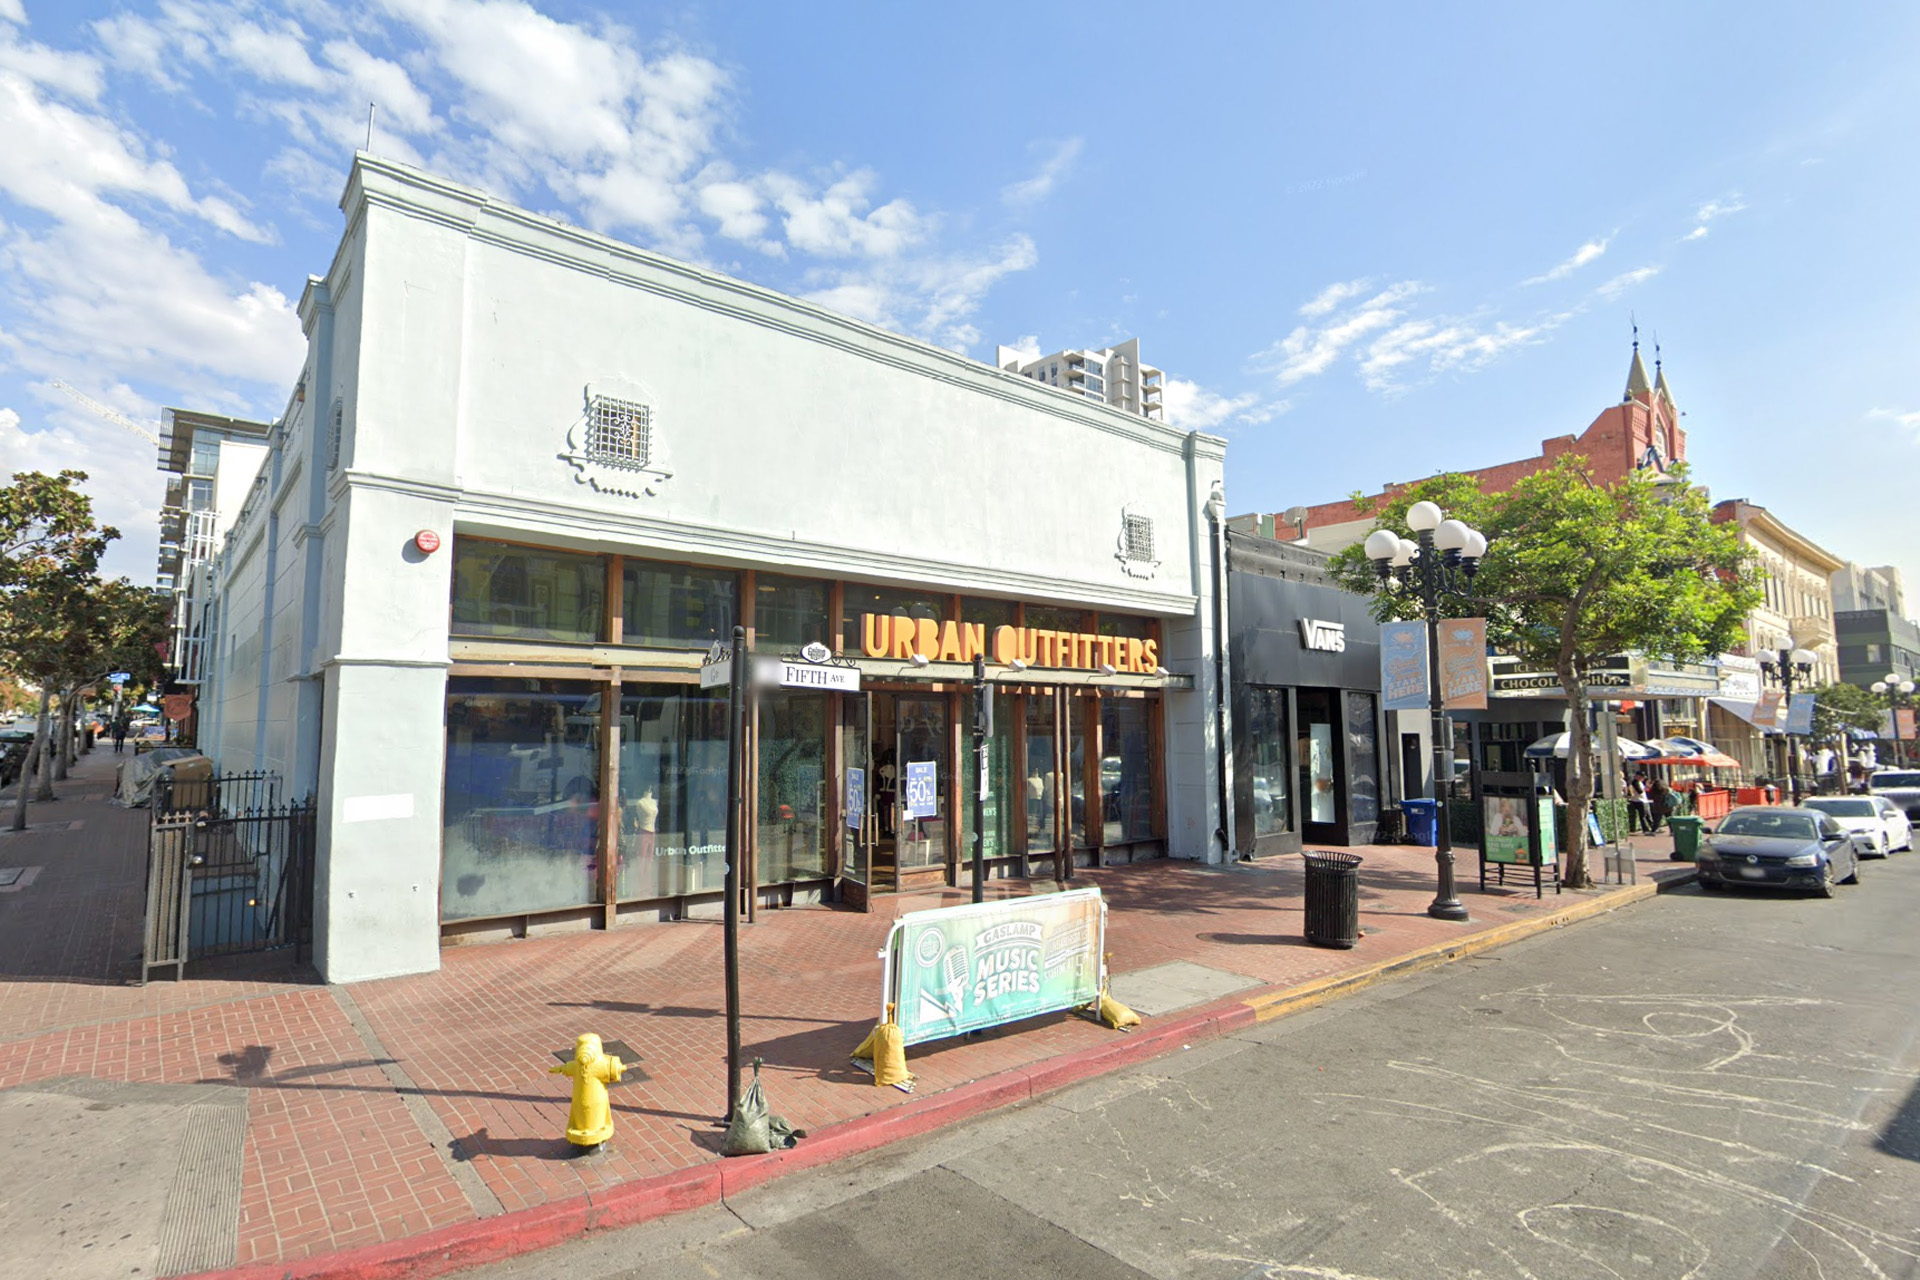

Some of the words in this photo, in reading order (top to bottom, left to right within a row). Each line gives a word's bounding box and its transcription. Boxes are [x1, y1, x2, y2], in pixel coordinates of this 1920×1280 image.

[861, 613, 985, 661] URBAN
[992, 624, 1158, 674] OUTFITTERS
[1302, 617, 1346, 653] VANS
[786, 666, 827, 685] FIFTH
[830, 673, 845, 683] AVE
[1501, 677, 1563, 689] CHOCOLA
[655, 847, 687, 857] Urban
[688, 844, 727, 855] Outfitte
[983, 923, 1036, 944] GASLAMP
[976, 947, 1040, 984] MUSIC
[973, 970, 1041, 1007] SERIES
